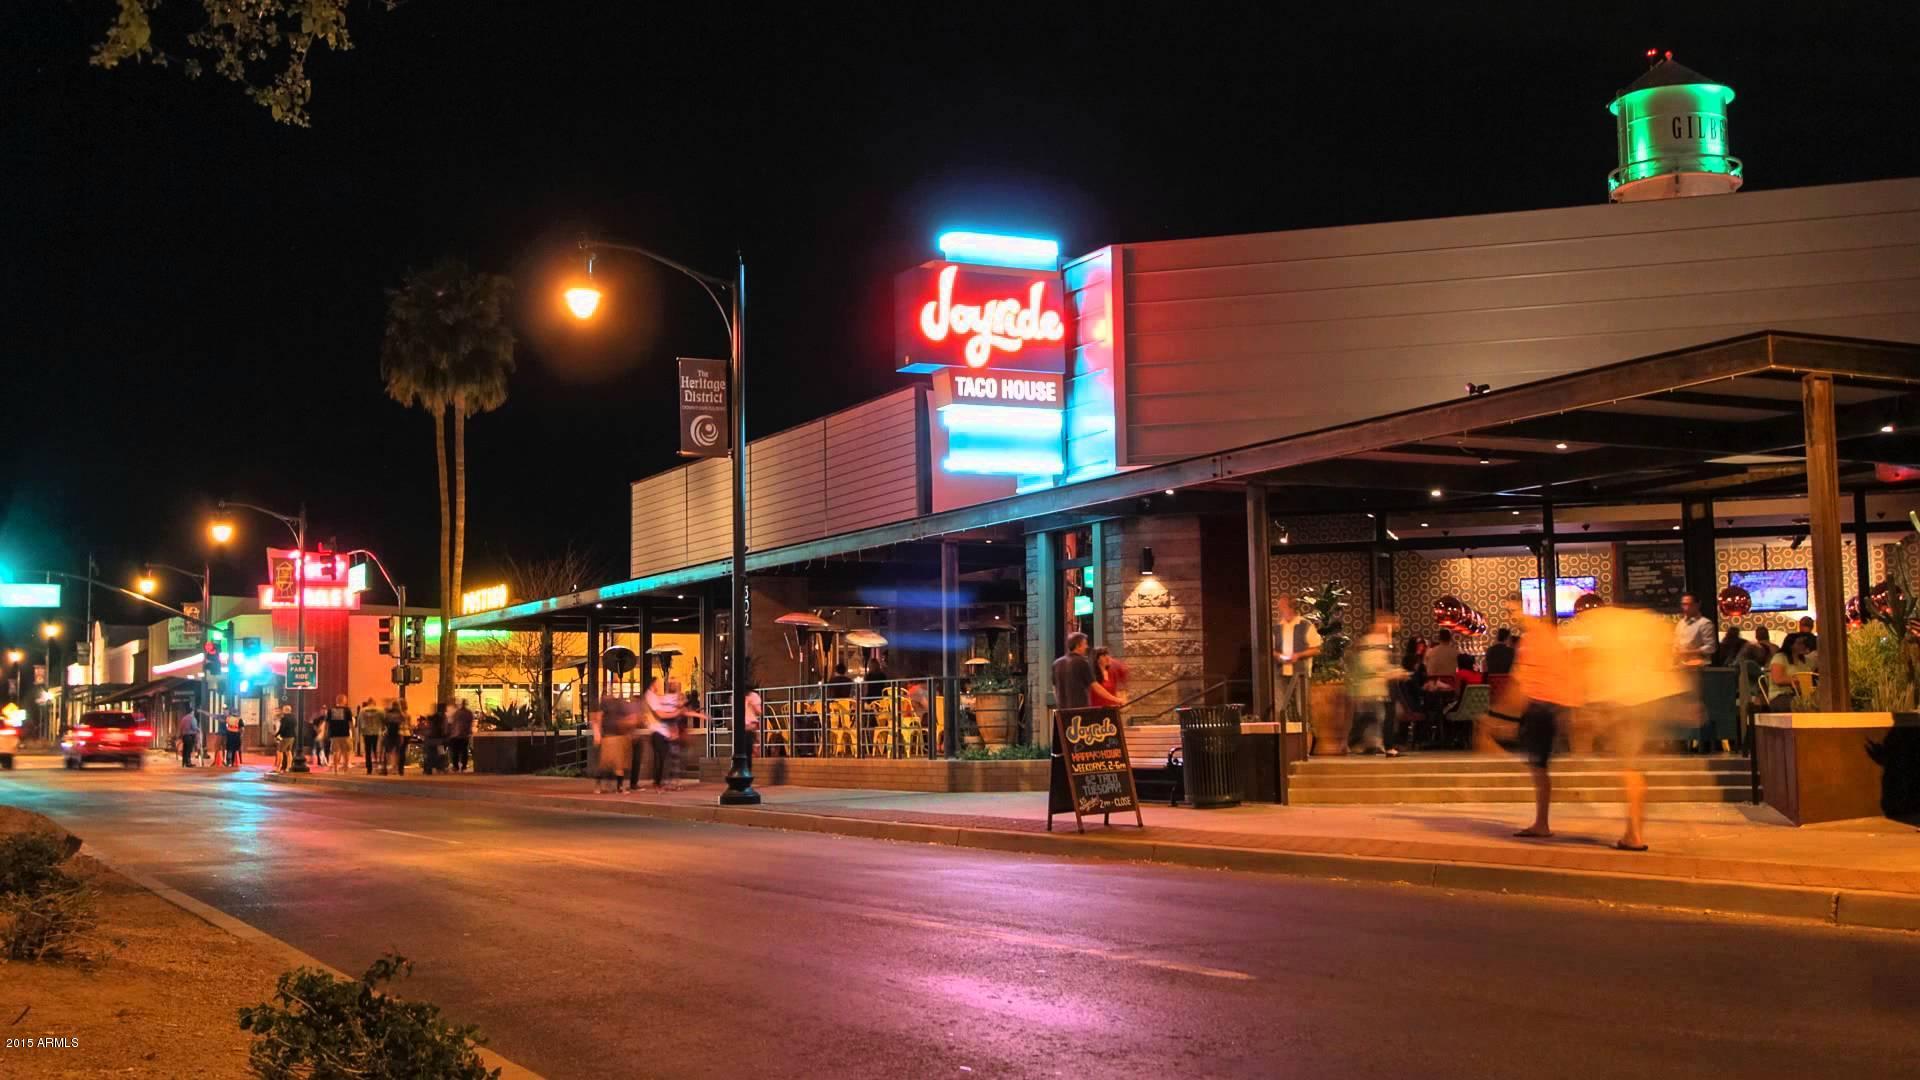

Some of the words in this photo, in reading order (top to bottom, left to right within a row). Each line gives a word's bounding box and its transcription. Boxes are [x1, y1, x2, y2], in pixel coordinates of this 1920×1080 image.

[1672, 116, 1727, 143] GILBE
[921, 265, 1064, 368] Joyride
[697, 369, 709, 378] The
[681, 375, 726, 392] Heritage
[955, 375, 998, 399] TACO
[1001, 378, 1057, 402] HOUSE
[684, 389, 723, 403] District
[1114, 796, 1132, 807] CLOSE
